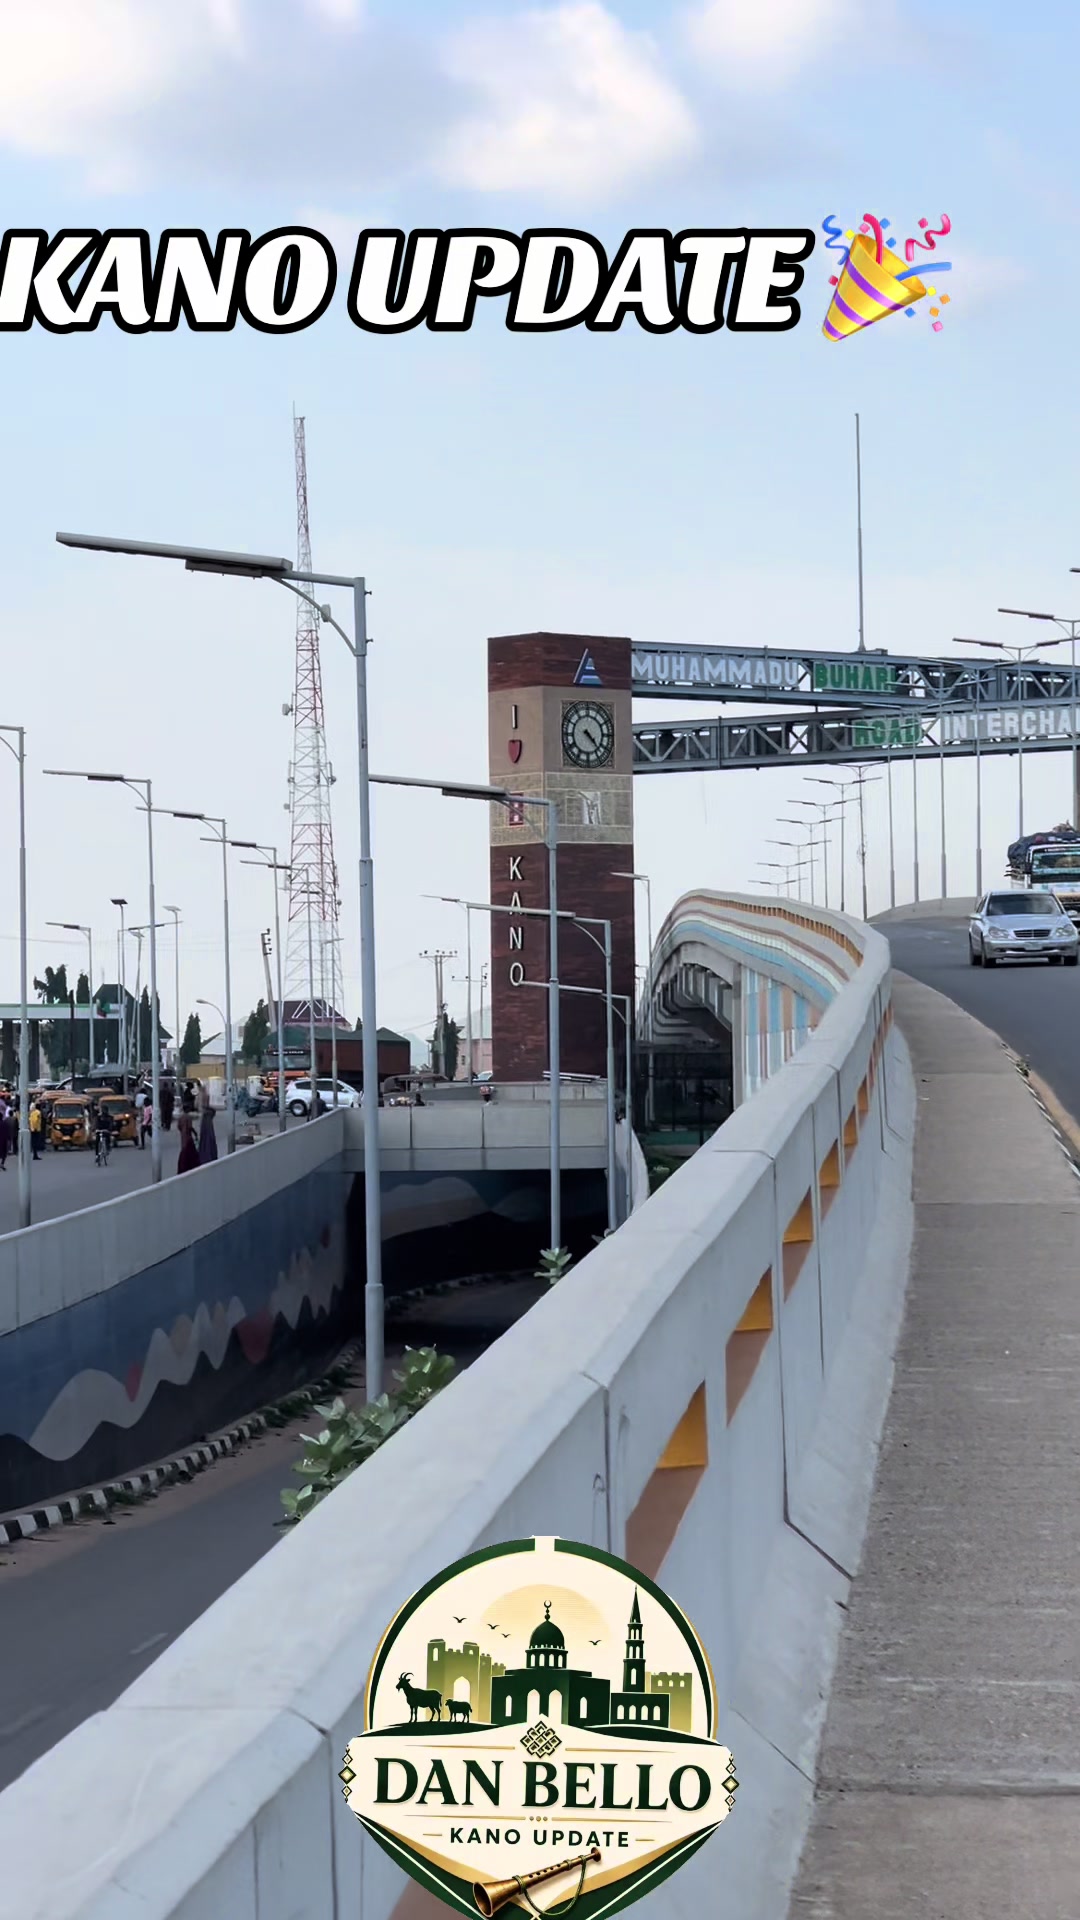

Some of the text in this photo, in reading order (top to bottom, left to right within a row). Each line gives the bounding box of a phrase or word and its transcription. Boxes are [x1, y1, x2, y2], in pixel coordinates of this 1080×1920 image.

[632, 653, 895, 692] MUHAMMADU BUHARI
[854, 718, 920, 746] ROAD
[509, 856, 524, 987] KANO
